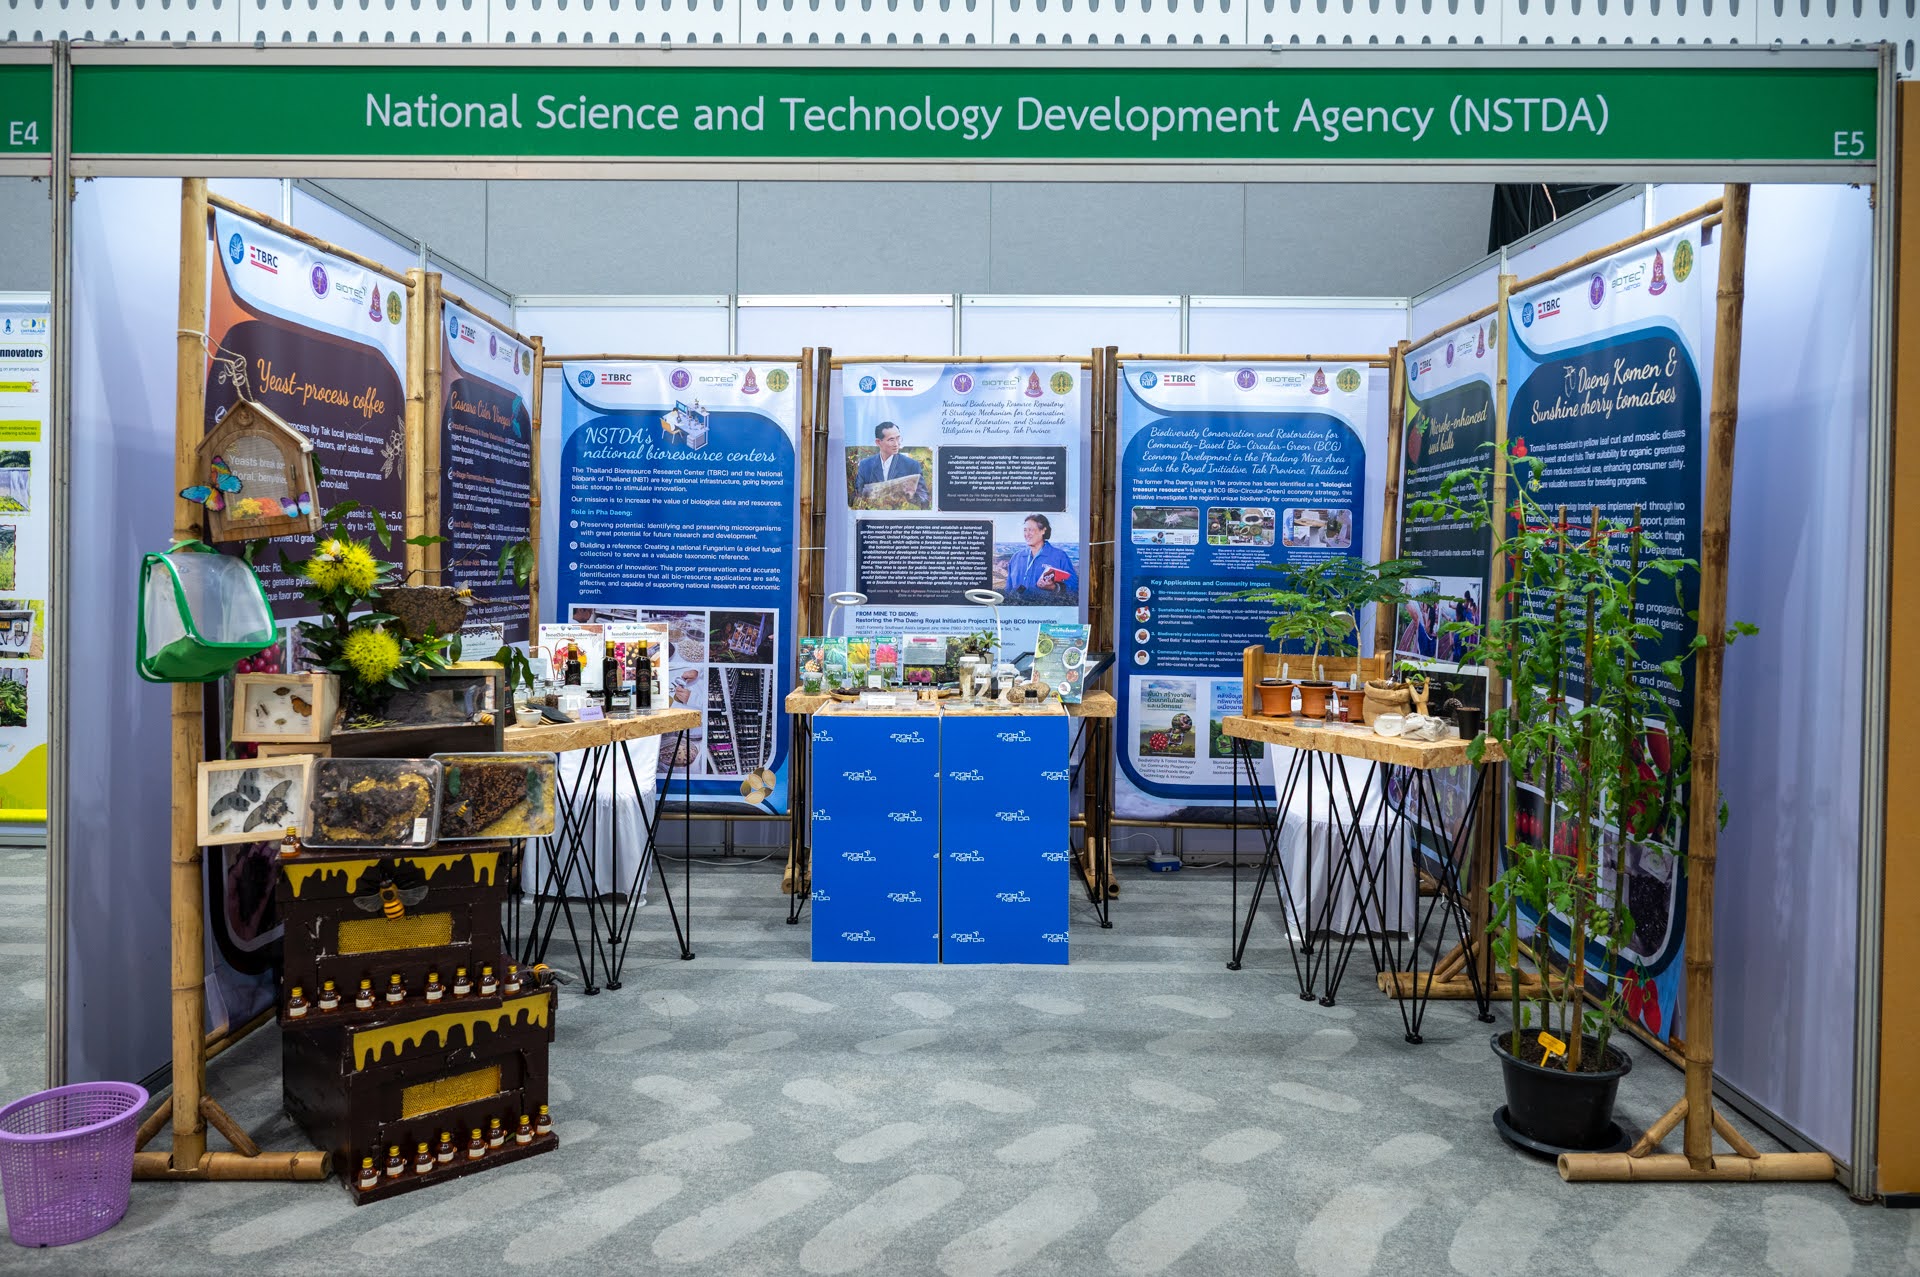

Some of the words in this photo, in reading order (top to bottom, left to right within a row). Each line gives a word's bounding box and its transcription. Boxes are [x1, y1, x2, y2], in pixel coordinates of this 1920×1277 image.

[367, 94, 522, 129] National
[537, 95, 679, 130] Science
[694, 95, 764, 131] and
[780, 95, 1002, 140] Technology
[1018, 96, 1279, 141] Development
[1293, 98, 1434, 142] Agency
[1450, 94, 1608, 135] (NSTDA)
[10, 121, 39, 145] E4
[1834, 131, 1864, 156] E5
[256, 249, 278, 267] TBRC
[1542, 298, 1560, 313] TBRC
[1171, 374, 1196, 383] TBRC
[1578, 367, 1609, 394] Daeng
[1613, 358, 1662, 386] Komen
[1665, 346, 1677, 377] &
[257, 358, 350, 406] Yeast-process
[353, 387, 385, 418] coffee
[1531, 396, 1579, 424] Sunshine
[1580, 391, 1613, 419] cherry
[1616, 383, 1676, 410] tomatoes
[1014, 409, 1023, 417] for
[1429, 401, 1488, 437] Microbe-enhanced
[311, 424, 319, 435] (by
[321, 426, 330, 435] Tak
[332, 428, 344, 438] local
[346, 432, 363, 441] yeasts)
[364, 434, 384, 444] improves
[585, 427, 653, 444] NSTDA's
[1151, 427, 1199, 439] Biodiversity
[1202, 428, 1255, 438] Conservation
[1257, 429, 1274, 438] and
[1276, 429, 1324, 438] Restoration
[1325, 429, 1338, 441] for
[1530, 443, 1545, 452] Tomato
[1546, 441, 1557, 450] lines
[1558, 439, 1578, 449] resistant
[1578, 439, 1583, 447] to
[1583, 437, 1598, 448] yellow
[1600, 436, 1609, 445] leaf
[1610, 435, 1620, 444] curl
[1622, 434, 1633, 443] and
[1634, 432, 1660, 442] mosaic
[1662, 429, 1685, 439] diseases
[1147, 439, 1225, 451] Community-Based
[1227, 440, 1310, 451] Bio-Circular-Green
[1314, 442, 1342, 451] (BCG)
[1428, 435, 1440, 455] seed
[1440, 432, 1454, 453] balls
[230, 455, 257, 467] Yeasts
[583, 445, 642, 460] national
[646, 445, 723, 461] bioresource
[726, 448, 776, 462] centers
[1142, 451, 1177, 462] Economy
[1180, 451, 1231, 463] Development
[1245, 453, 1259, 462] the
[1261, 453, 1299, 464] Phadang
[1301, 453, 1323, 462] Mine
[1324, 454, 1345, 462] Area
[706, 469, 728, 477] (TBRC)
[1140, 463, 1164, 472] under
[1166, 463, 1179, 472] the
[1182, 463, 1207, 475] Royal
[1207, 463, 1247, 474] Initiative,
[1252, 464, 1267, 474] Tak
[1310, 465, 1349, 475] Thailand
[1227, 480, 1250, 488] province
[1320, 481, 1352, 489] "biological
[610, 509, 632, 518] Daeng:
[1163, 580, 1200, 588] Applications
[1215, 580, 1247, 588] Community
[1249, 581, 1270, 589] Impact
